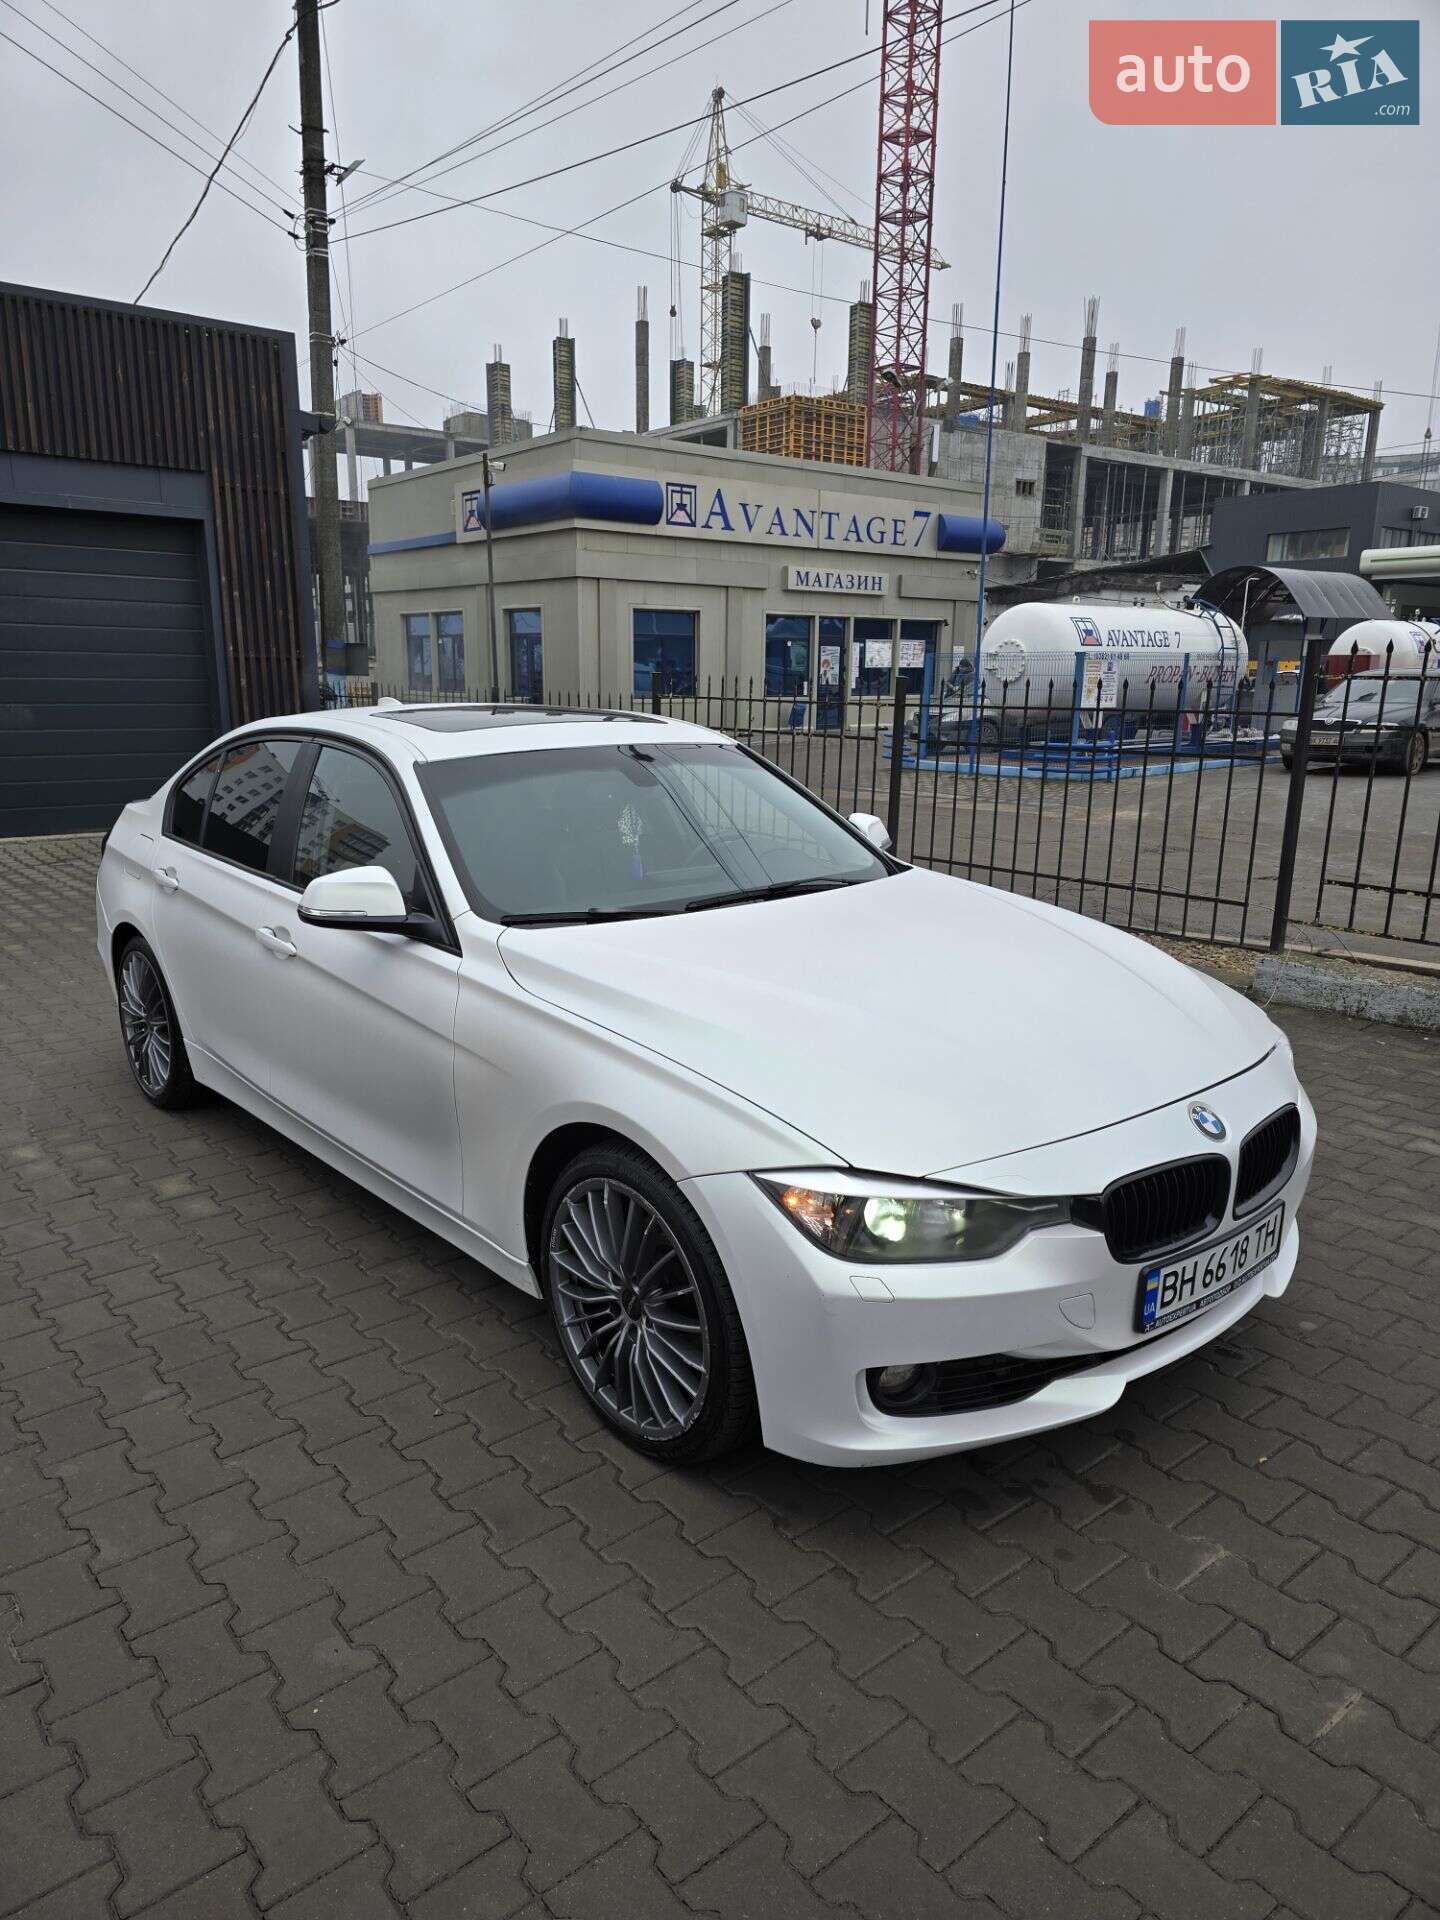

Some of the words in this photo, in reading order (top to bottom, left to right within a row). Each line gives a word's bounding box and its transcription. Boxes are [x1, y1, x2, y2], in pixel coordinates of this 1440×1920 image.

[795, 570, 883, 592] МАГАЗИН
[1106, 629, 1171, 648] AVANTAGE
[1174, 631, 1181, 649] 7
[1160, 1260, 1199, 1310] BH
[1202, 1235, 1250, 1288] 6618
[1255, 1214, 1279, 1258] TH
[1144, 1302, 1156, 1316] UA
